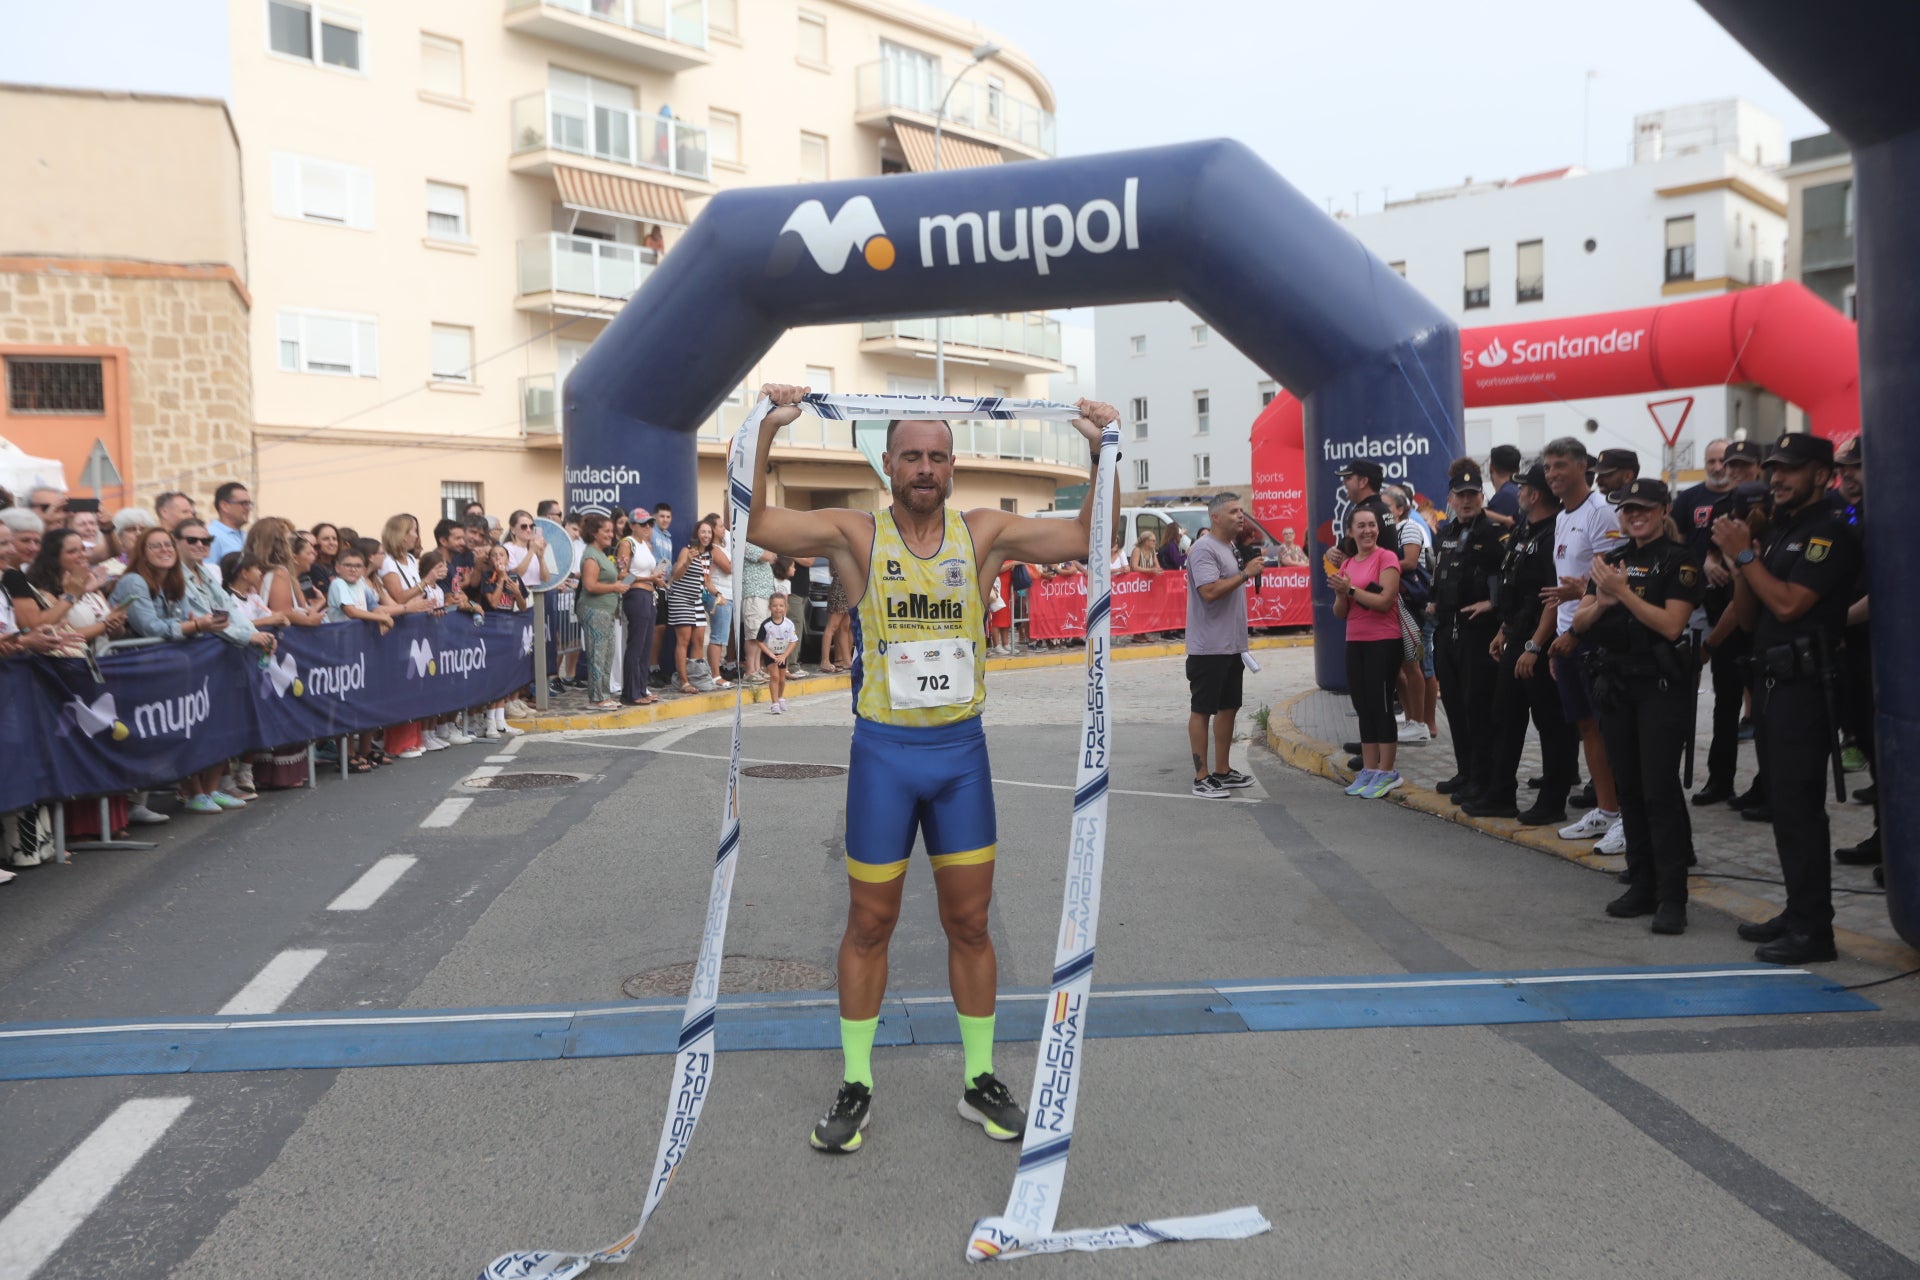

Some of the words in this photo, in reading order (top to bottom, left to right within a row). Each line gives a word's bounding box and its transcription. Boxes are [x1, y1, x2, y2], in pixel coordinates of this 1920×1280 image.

[918, 177, 1140, 276] mupol
[1511, 328, 1646, 365] Santander
[1323, 433, 1430, 461] fundación
[565, 465, 641, 484] fundación
[1255, 472, 1285, 483] Sports
[571, 484, 620, 507] mupol
[1040, 579, 1076, 600] Sports
[1111, 577, 1153, 595] tander
[308, 652, 365, 701] mupol
[440, 638, 487, 679] mupol
[917, 674, 950, 692] 702
[1094, 636, 1105, 769] NACIONAL
[134, 675, 210, 739] mupol
[1049, 993, 1082, 1132] NACIONAL
[654, 1052, 697, 1197] NACIONAL
